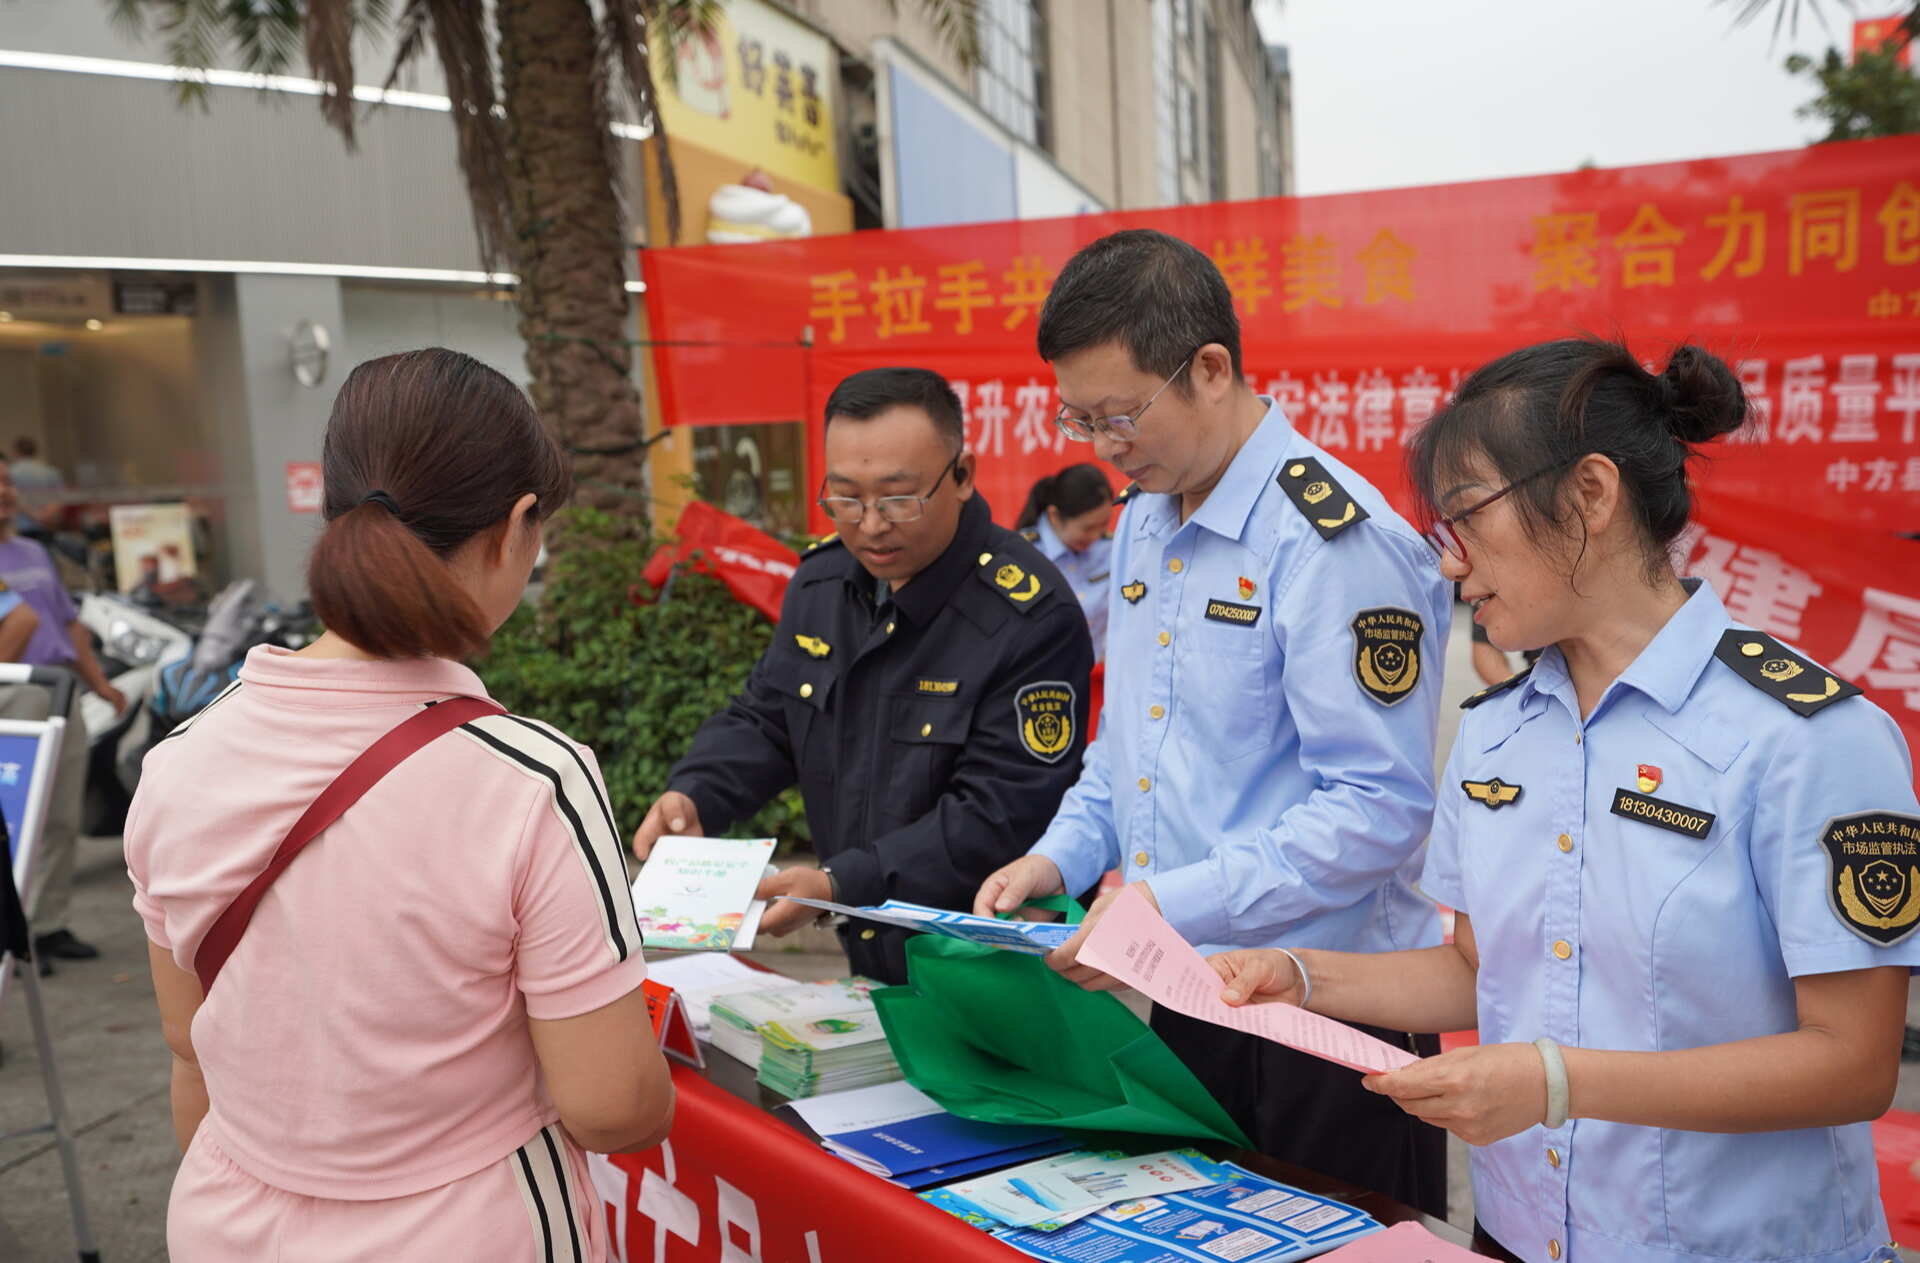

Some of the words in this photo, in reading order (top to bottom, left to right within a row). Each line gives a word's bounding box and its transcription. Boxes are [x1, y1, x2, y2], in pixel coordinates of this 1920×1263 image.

[1358, 614, 1420, 633] 中华人民共和国
[1364, 628, 1415, 642] 市场监管执法
[1618, 795, 1708, 834] 18130430007
[1831, 821, 1920, 844] 中华人民共和国
[1842, 840, 1918, 857] 市场监管执法
